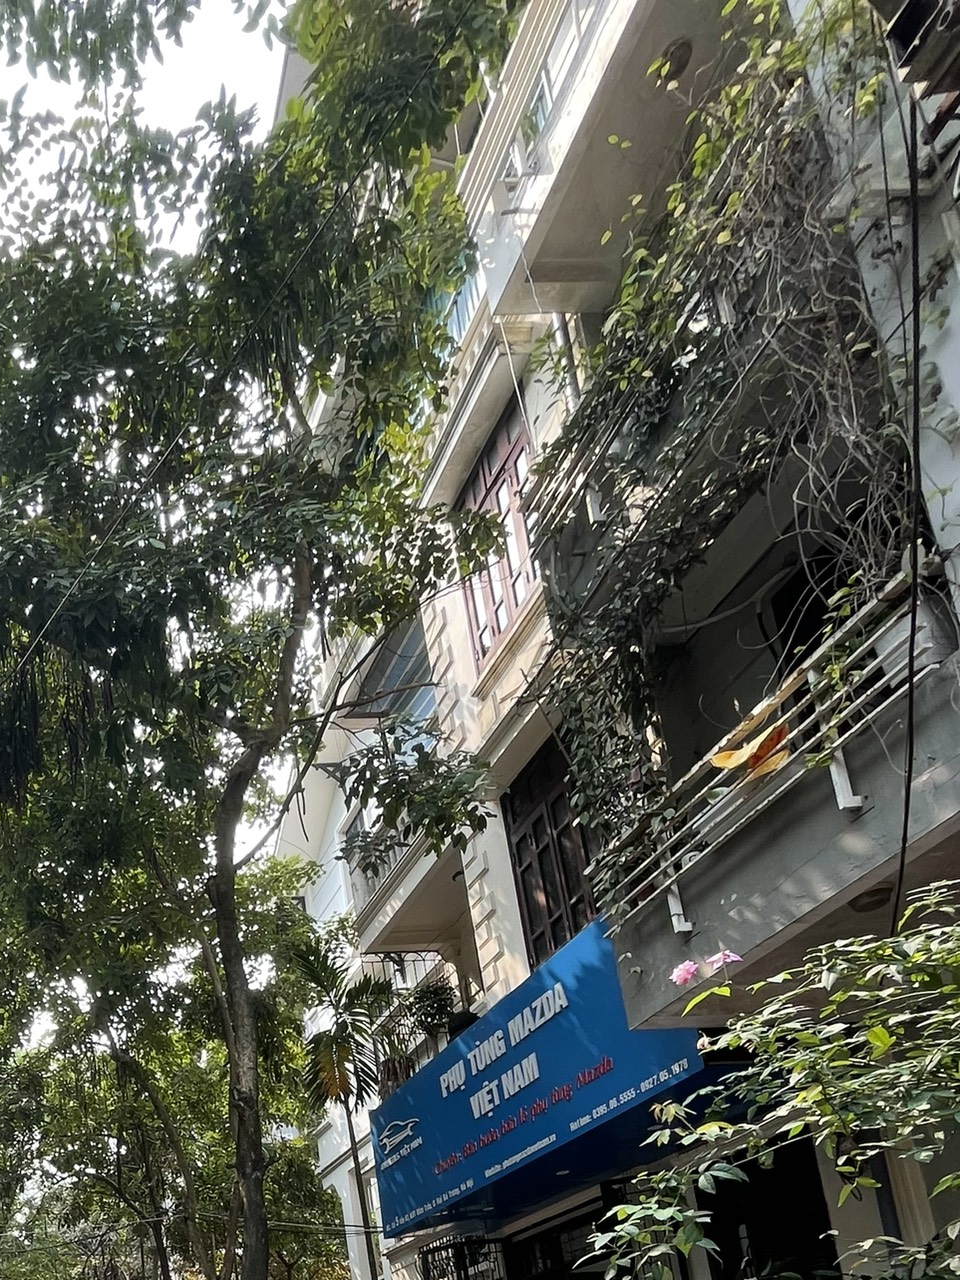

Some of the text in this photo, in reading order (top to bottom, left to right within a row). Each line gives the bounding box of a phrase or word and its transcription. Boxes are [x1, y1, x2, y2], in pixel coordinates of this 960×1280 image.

[440, 981, 569, 1098] PHỤ TÙNG MAZDA
[469, 1052, 540, 1120] VIỆT NAM
[576, 1055, 614, 1089] Mazda
[592, 1087, 636, 1119] 0395.06.5555
[640, 1058, 689, 1093] 0927.05.1978
